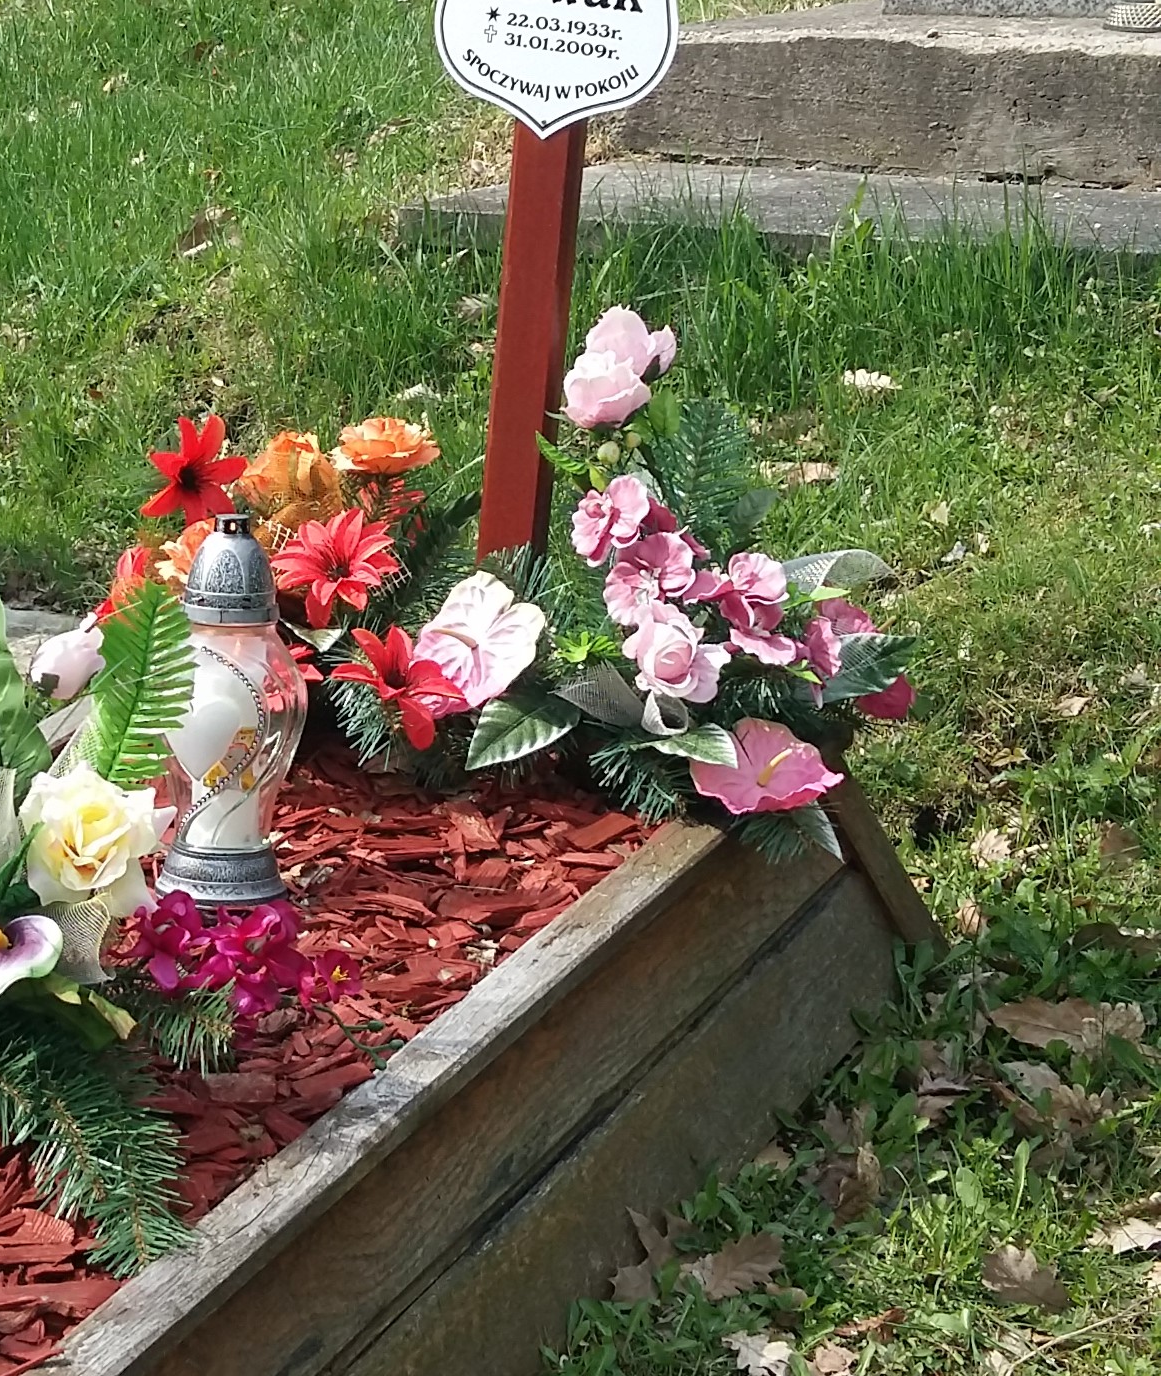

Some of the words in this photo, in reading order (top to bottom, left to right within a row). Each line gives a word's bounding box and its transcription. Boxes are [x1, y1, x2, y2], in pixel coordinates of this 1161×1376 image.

[506, 12, 623, 41] 22.03.1933r.
[504, 32, 620, 60] 31.01.2009r.
[462, 48, 550, 102] SPOCZYWAJ
[554, 85, 571, 100] W
[575, 64, 640, 99] POKOJU
